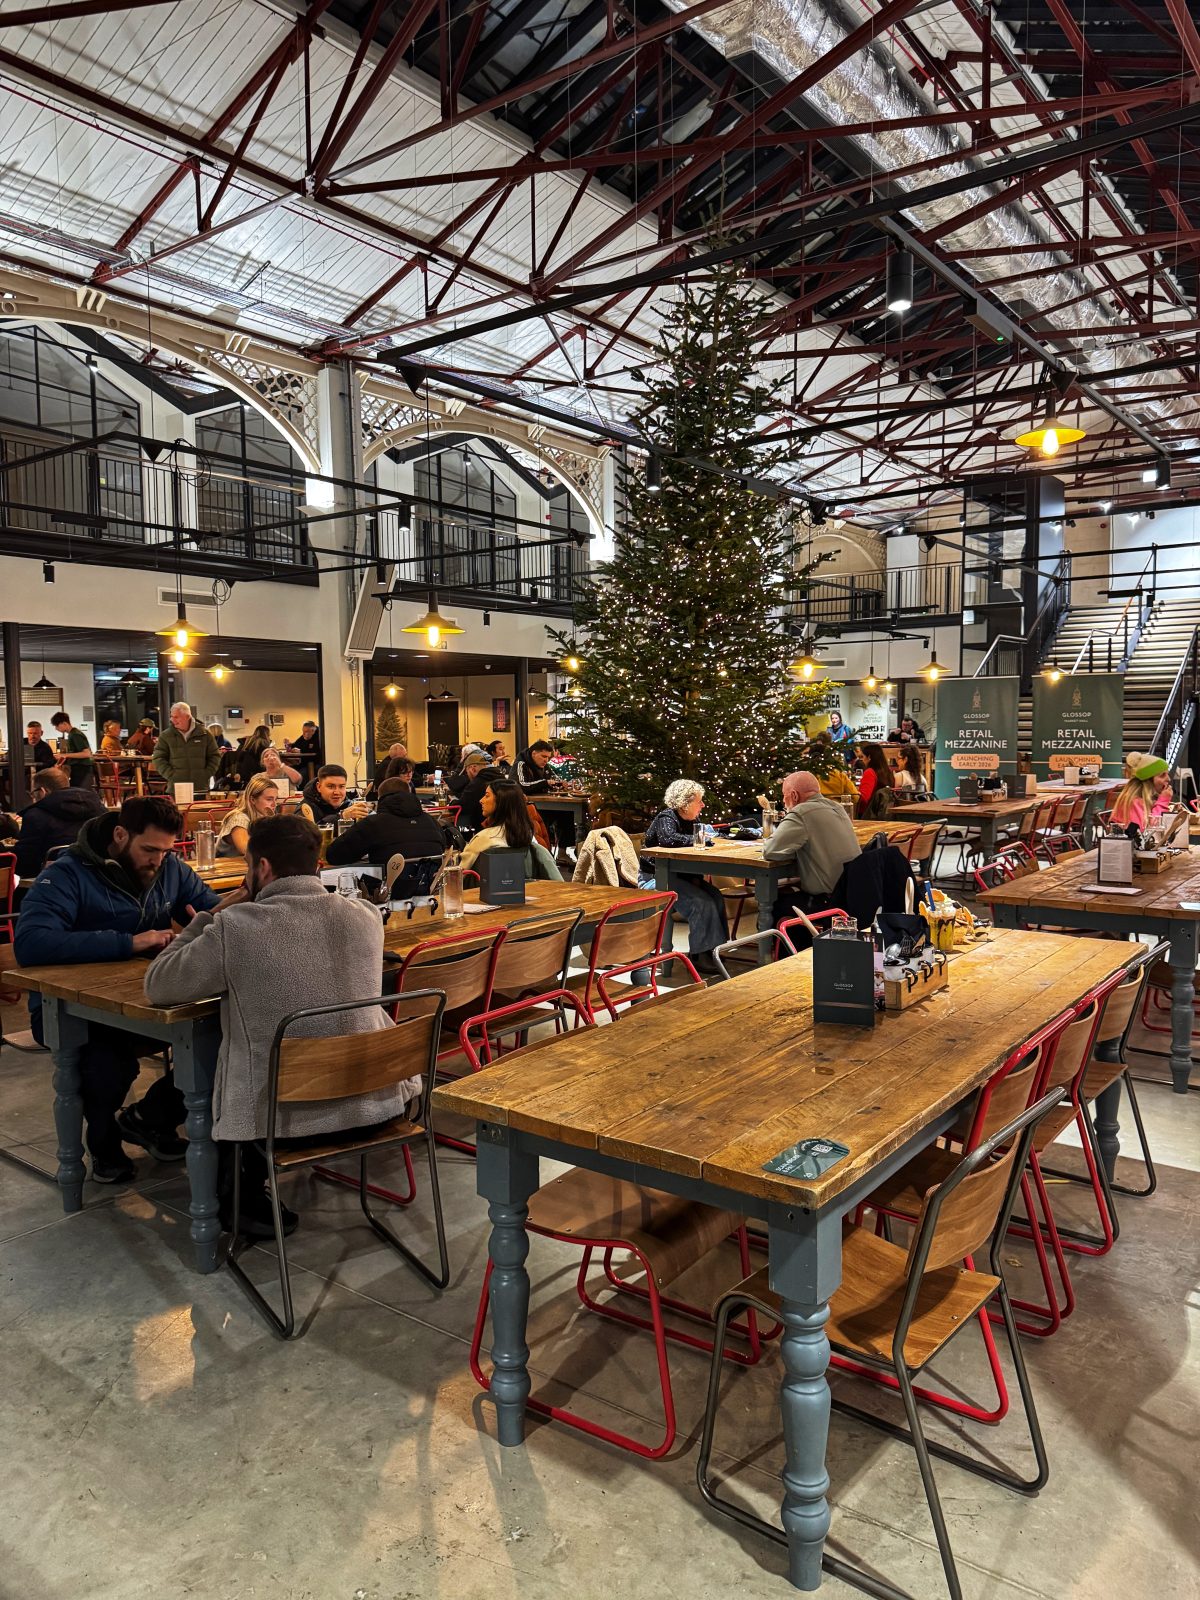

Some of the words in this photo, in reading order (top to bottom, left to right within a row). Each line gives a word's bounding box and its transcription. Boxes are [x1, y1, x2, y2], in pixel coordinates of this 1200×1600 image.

[958, 729, 994, 738] RETAIL
[1057, 729, 1096, 738] RETAIL
[944, 740, 1008, 749] MEZZANINE
[1041, 740, 1112, 749] MEZZANINE
